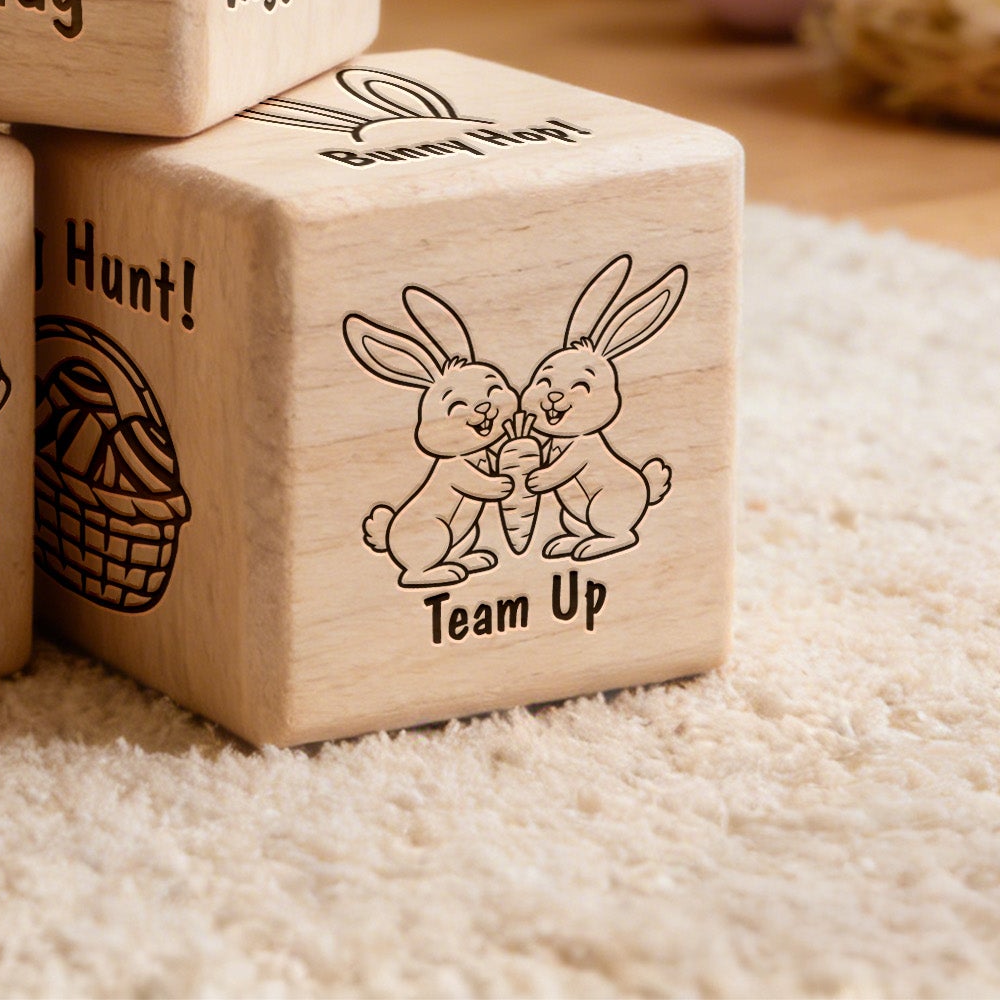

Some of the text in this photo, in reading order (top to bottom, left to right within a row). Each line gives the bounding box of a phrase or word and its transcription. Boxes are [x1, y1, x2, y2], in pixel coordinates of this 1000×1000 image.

[318, 120, 591, 167] Bunny Hop!
[66, 220, 196, 331] Hunt!
[424, 571, 607, 645] Team Up
